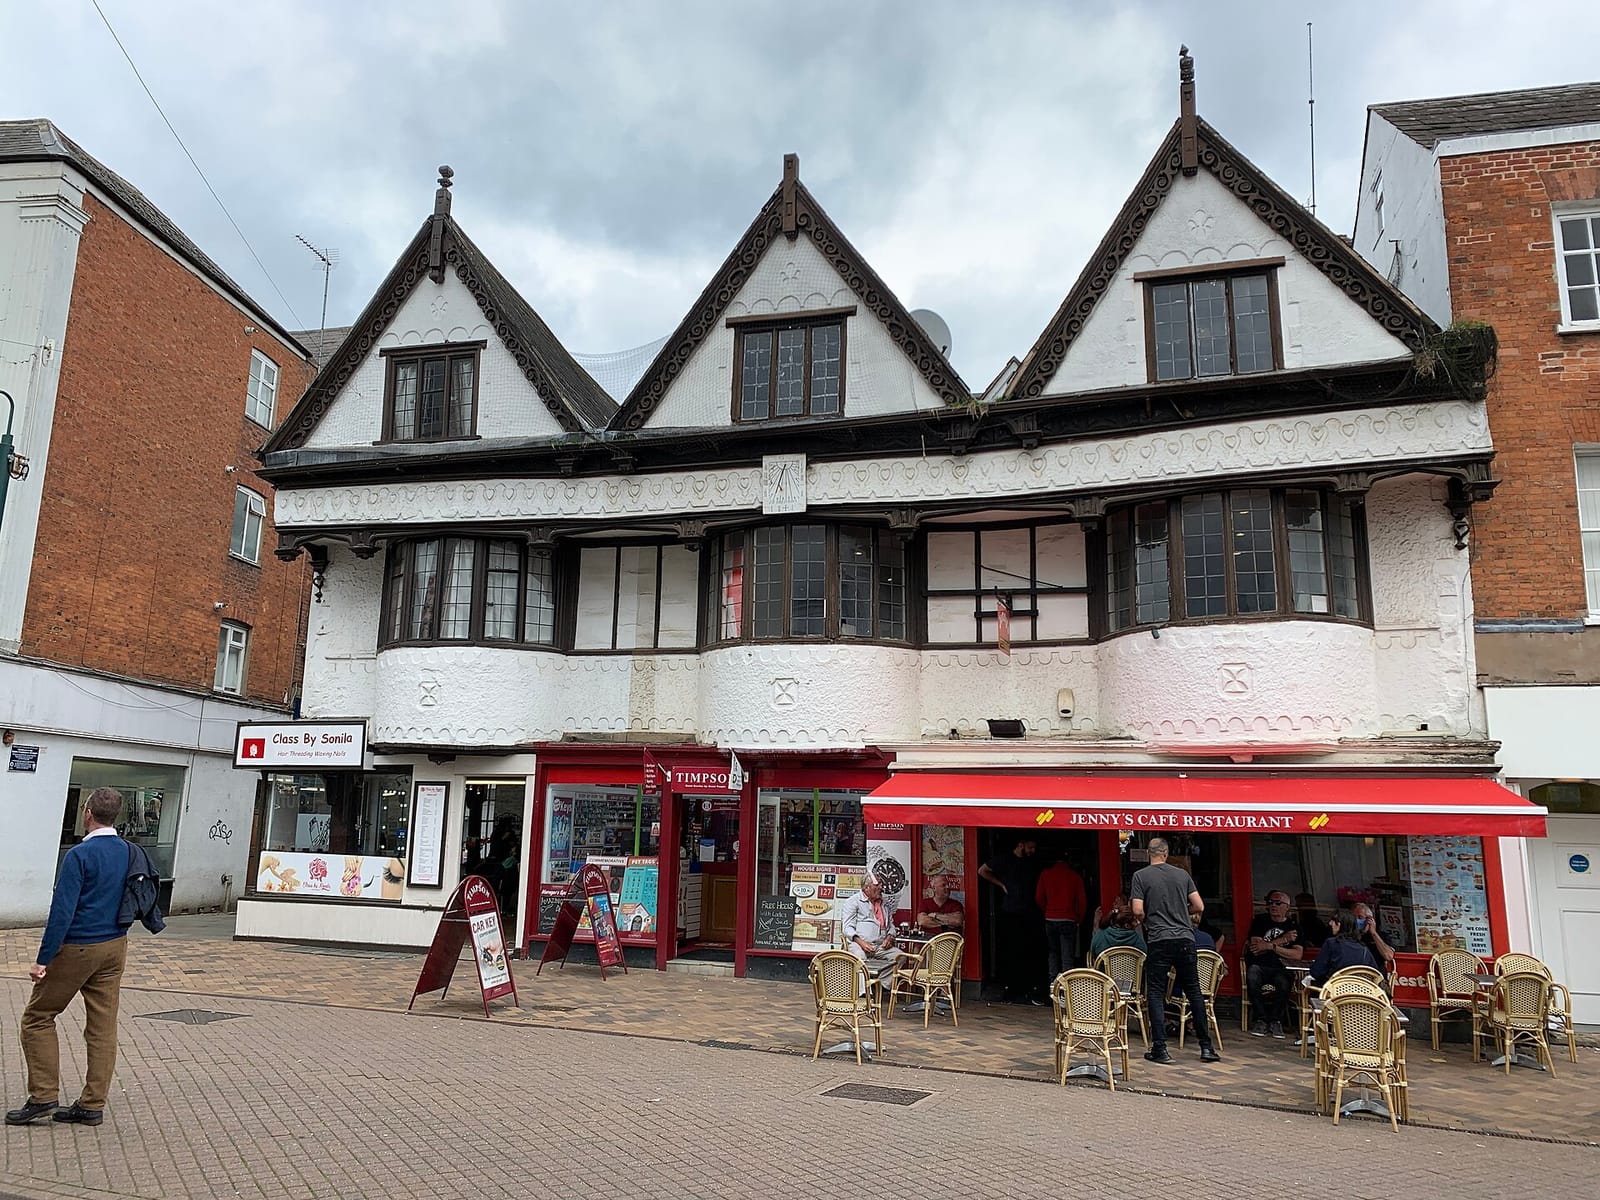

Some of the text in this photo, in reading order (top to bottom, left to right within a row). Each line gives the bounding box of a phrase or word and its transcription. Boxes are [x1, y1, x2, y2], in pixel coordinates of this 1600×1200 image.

[272, 732, 353, 747] Class By Sonila
[675, 772, 731, 783] TIMPSO
[1069, 812, 1295, 829] JENNY'S CAFÉ RESTAURANT
[467, 884, 491, 901] TIMPSON
[820, 888, 832, 897] 127
[776, 901, 794, 911] HEELS
[472, 916, 496, 934] CAR KEY
